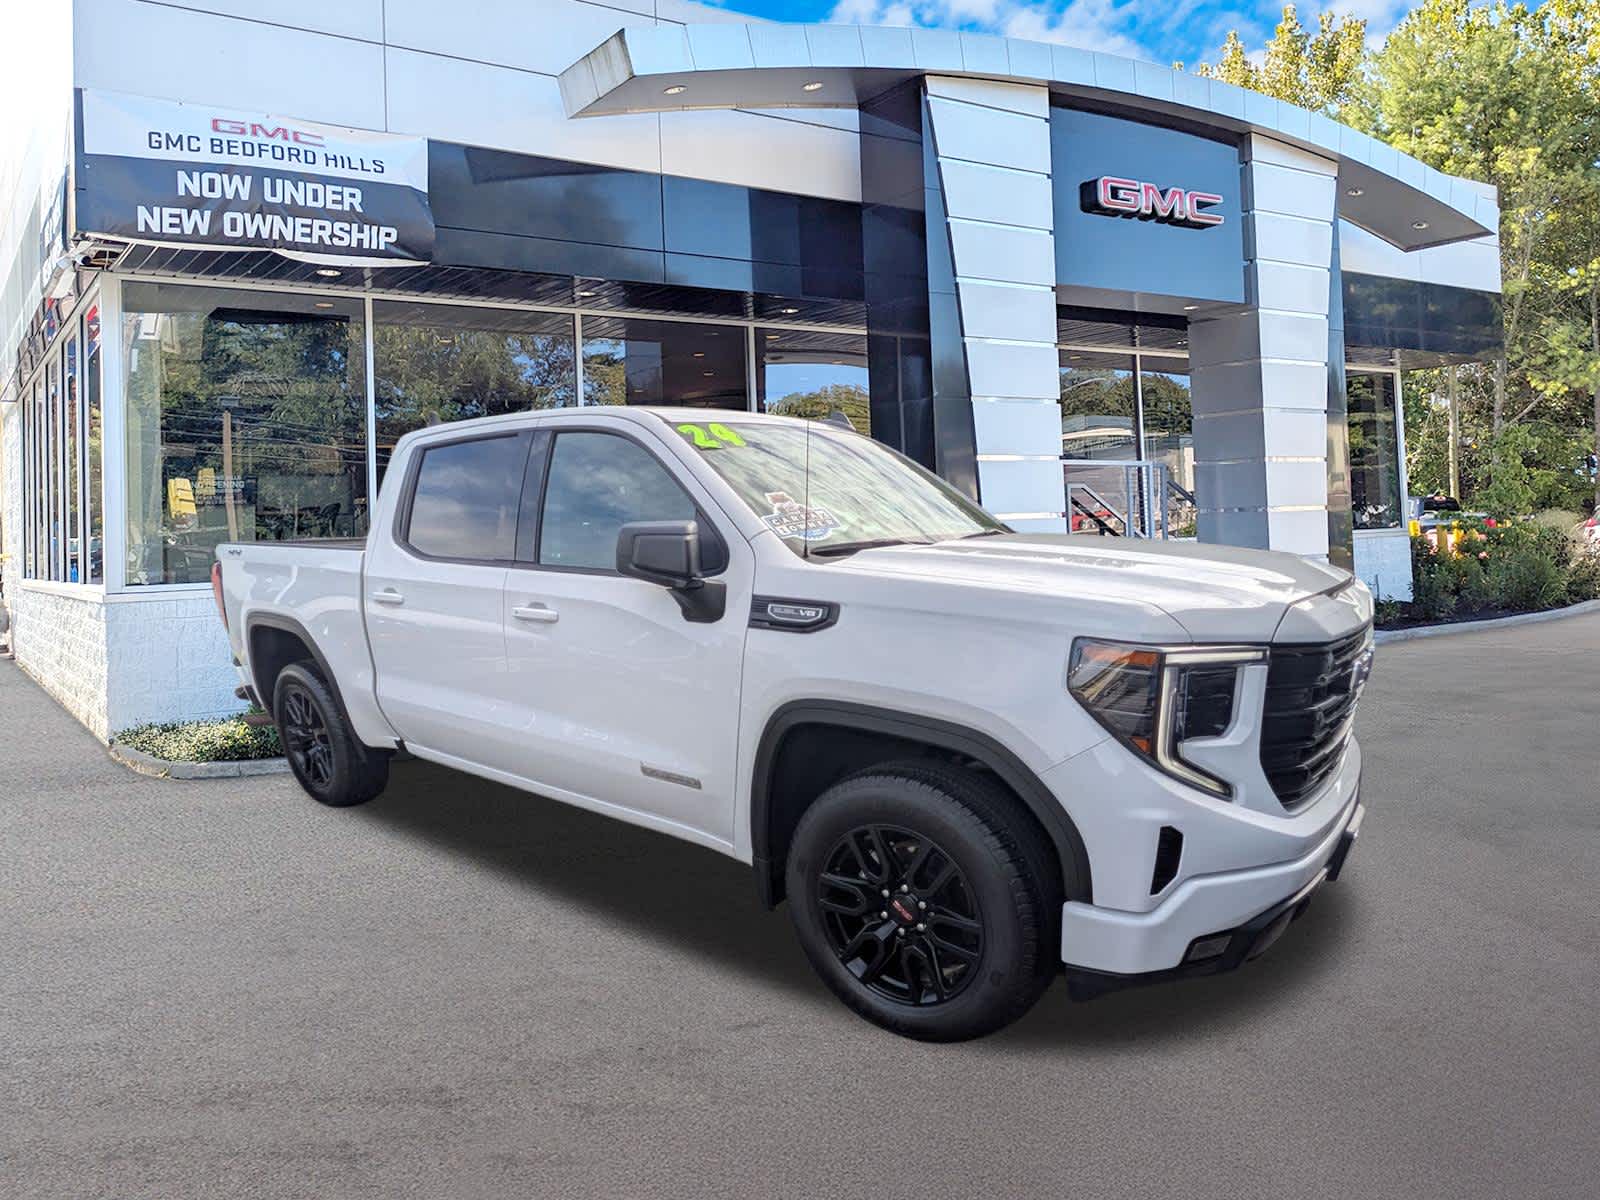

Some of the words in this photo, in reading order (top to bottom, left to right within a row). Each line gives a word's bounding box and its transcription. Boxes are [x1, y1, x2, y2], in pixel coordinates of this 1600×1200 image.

[148, 131, 201, 152] GMC
[210, 137, 317, 165] BEDFORD
[324, 152, 385, 174] HILLS
[210, 118, 325, 147] GMC
[177, 170, 252, 201] NOW
[263, 177, 364, 213] UNDER
[1096, 175, 1225, 225] GMC
[137, 205, 211, 236] NEW
[223, 211, 398, 250] OWNERSHIP
[676, 423, 746, 449] 24
[800, 609, 816, 617] V8
